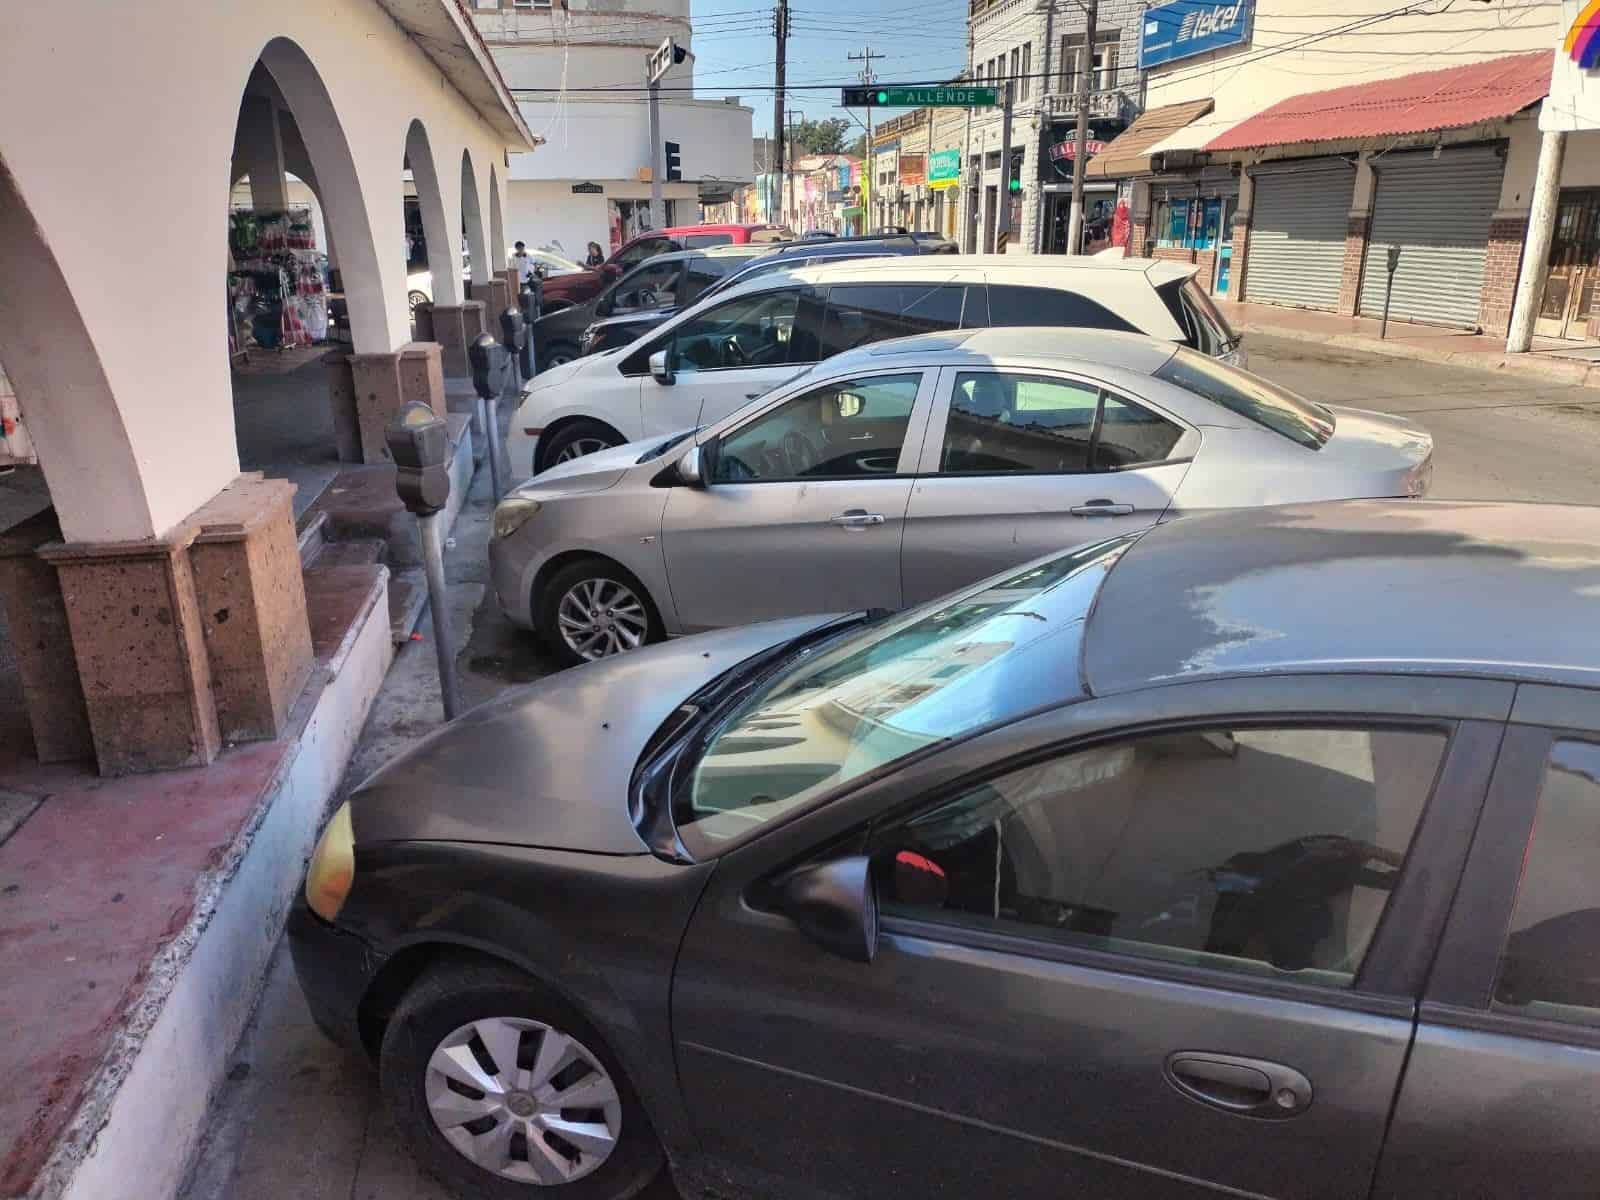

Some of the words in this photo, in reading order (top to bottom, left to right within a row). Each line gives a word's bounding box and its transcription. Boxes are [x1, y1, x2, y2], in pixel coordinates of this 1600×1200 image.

[1191, 0, 1242, 39] telcel
[906, 91, 976, 103] ALLENDE
[1052, 142, 1104, 157] VALCIA
